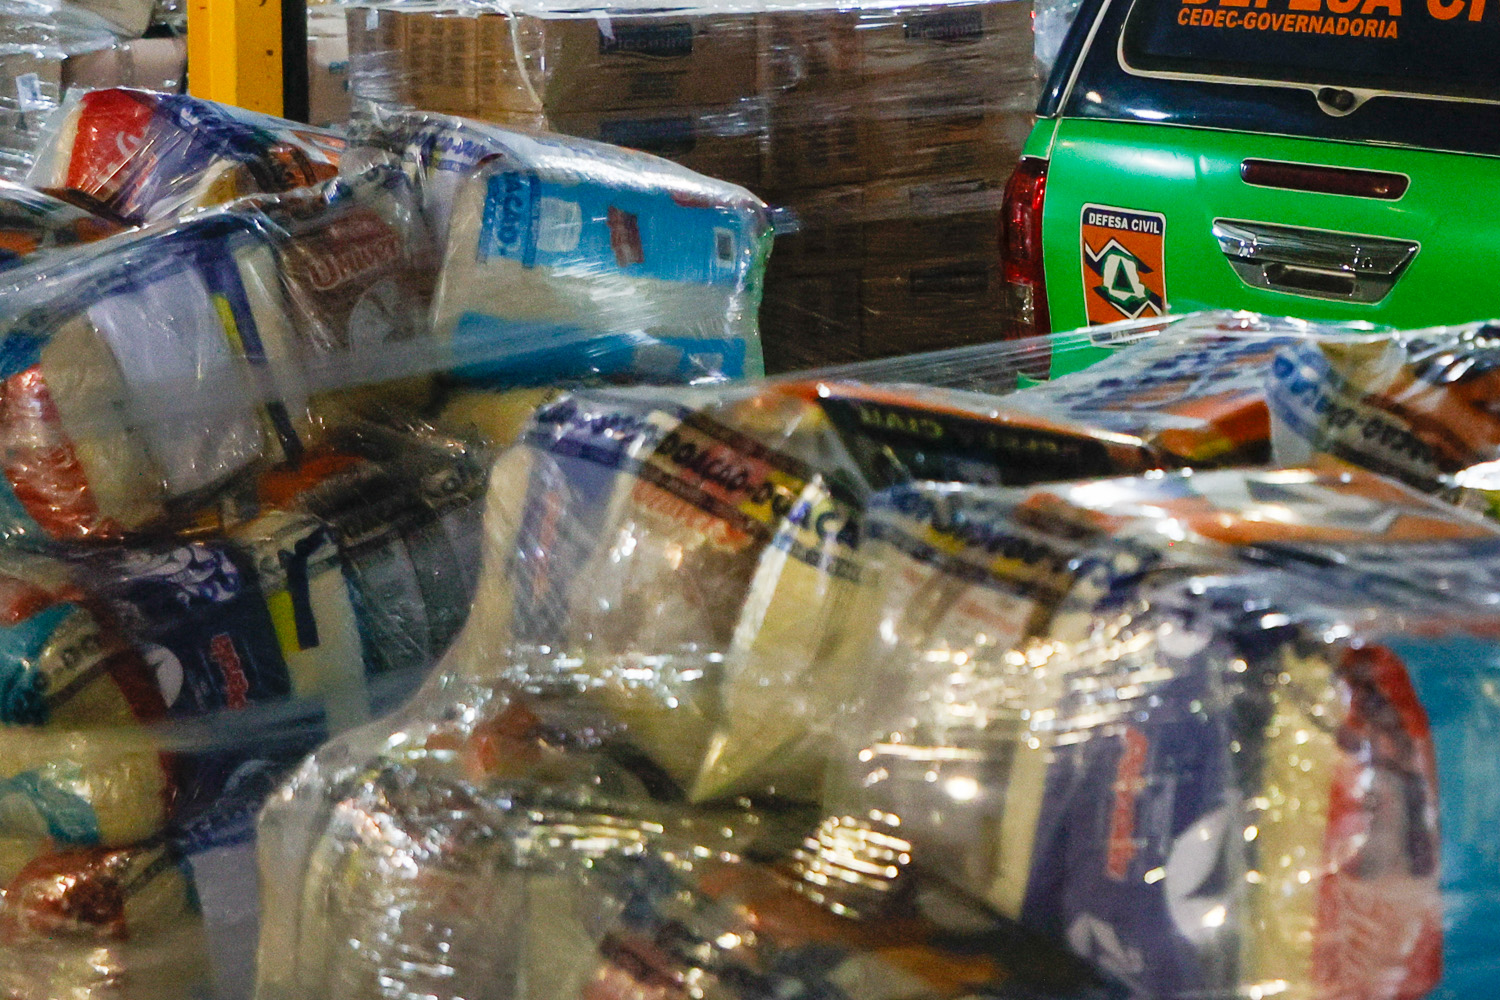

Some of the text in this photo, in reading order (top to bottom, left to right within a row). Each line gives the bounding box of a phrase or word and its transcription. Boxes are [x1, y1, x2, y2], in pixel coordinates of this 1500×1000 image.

[1176, 7, 1399, 40] CEDEC-GOVERNADORIA
[1088, 212, 1160, 234] DEFESA CIVIL
